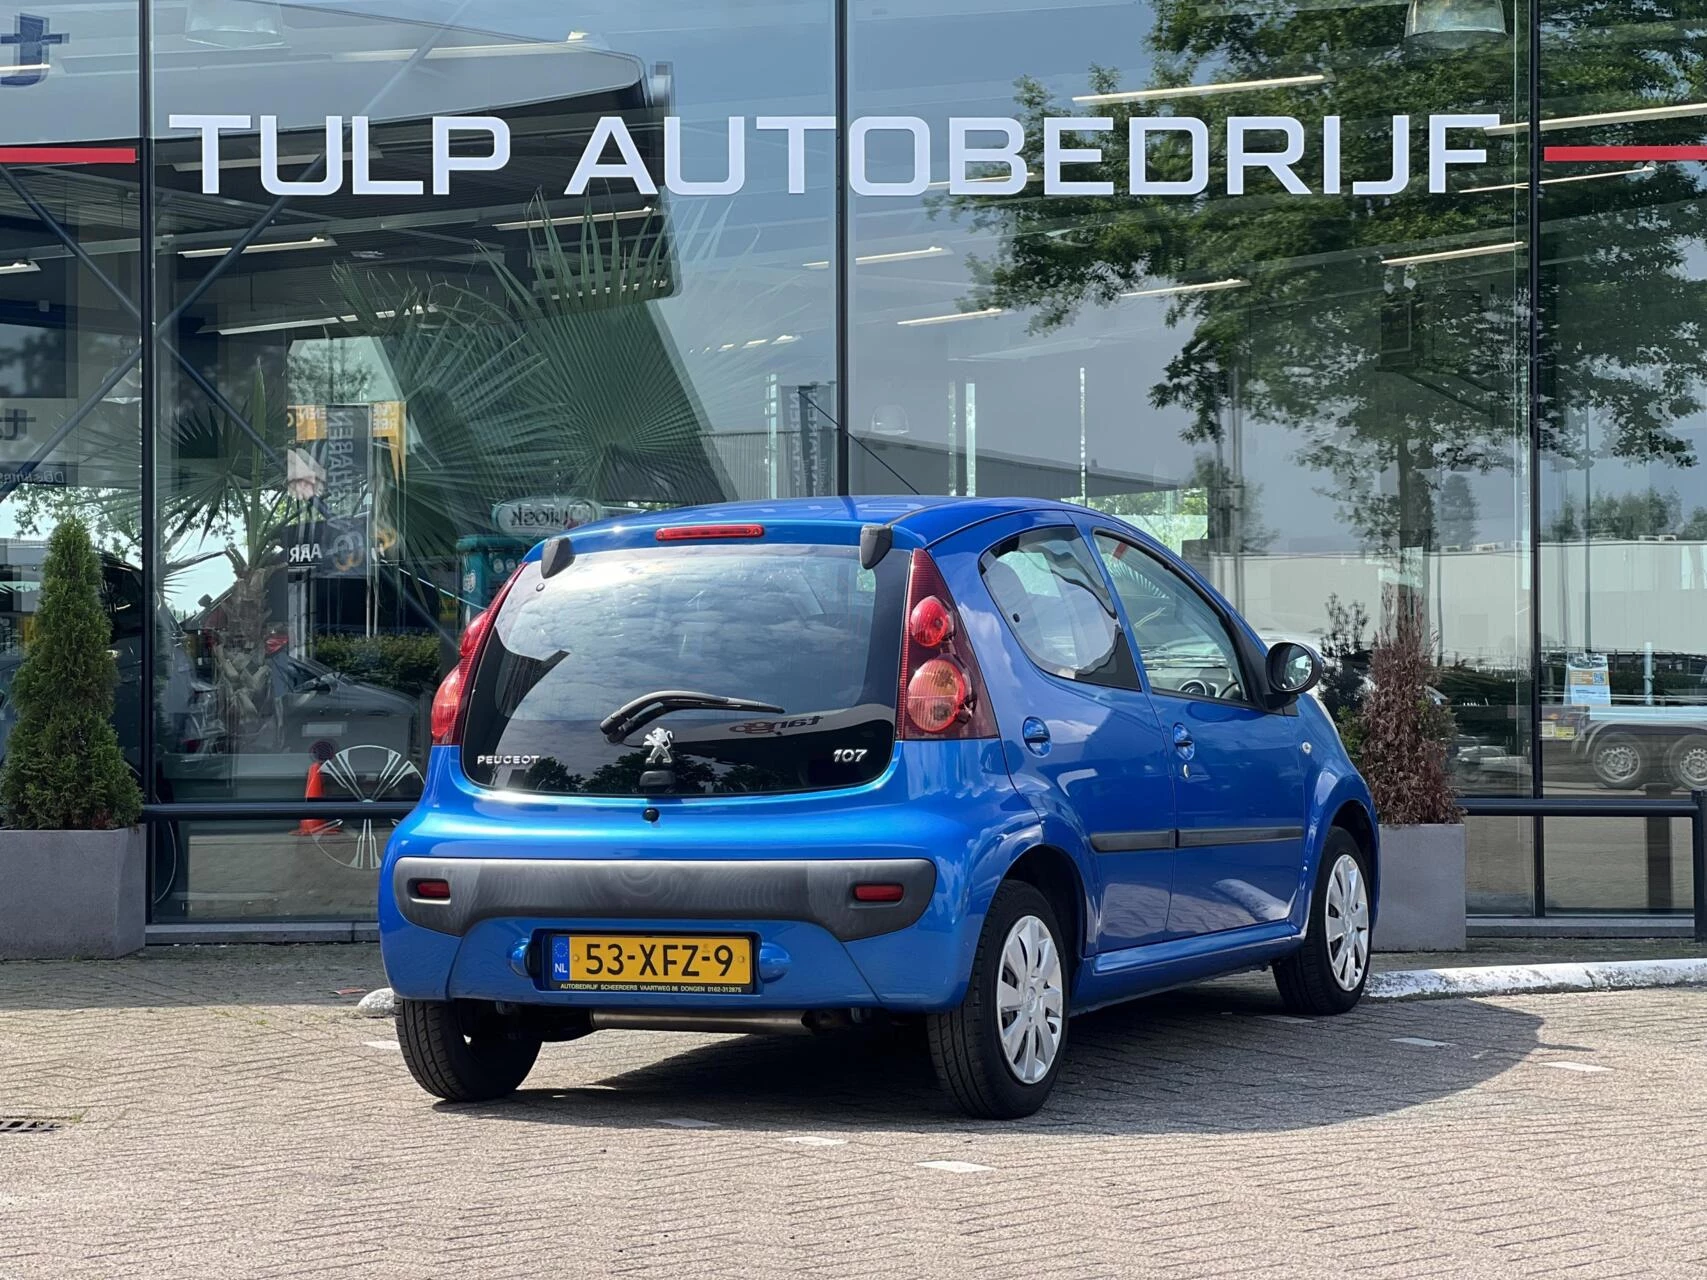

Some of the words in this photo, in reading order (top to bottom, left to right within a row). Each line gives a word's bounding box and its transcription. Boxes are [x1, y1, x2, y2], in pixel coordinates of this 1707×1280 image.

[168, 115, 511, 197] TULP
[564, 114, 1500, 197] AUTOBEDRIJF
[477, 755, 540, 764] PEUGEOT
[833, 749, 868, 762] 107
[555, 963, 568, 973] NL
[585, 944, 734, 977] 53-XFZ-9
[640, 984, 671, 992] VAARTWEG
